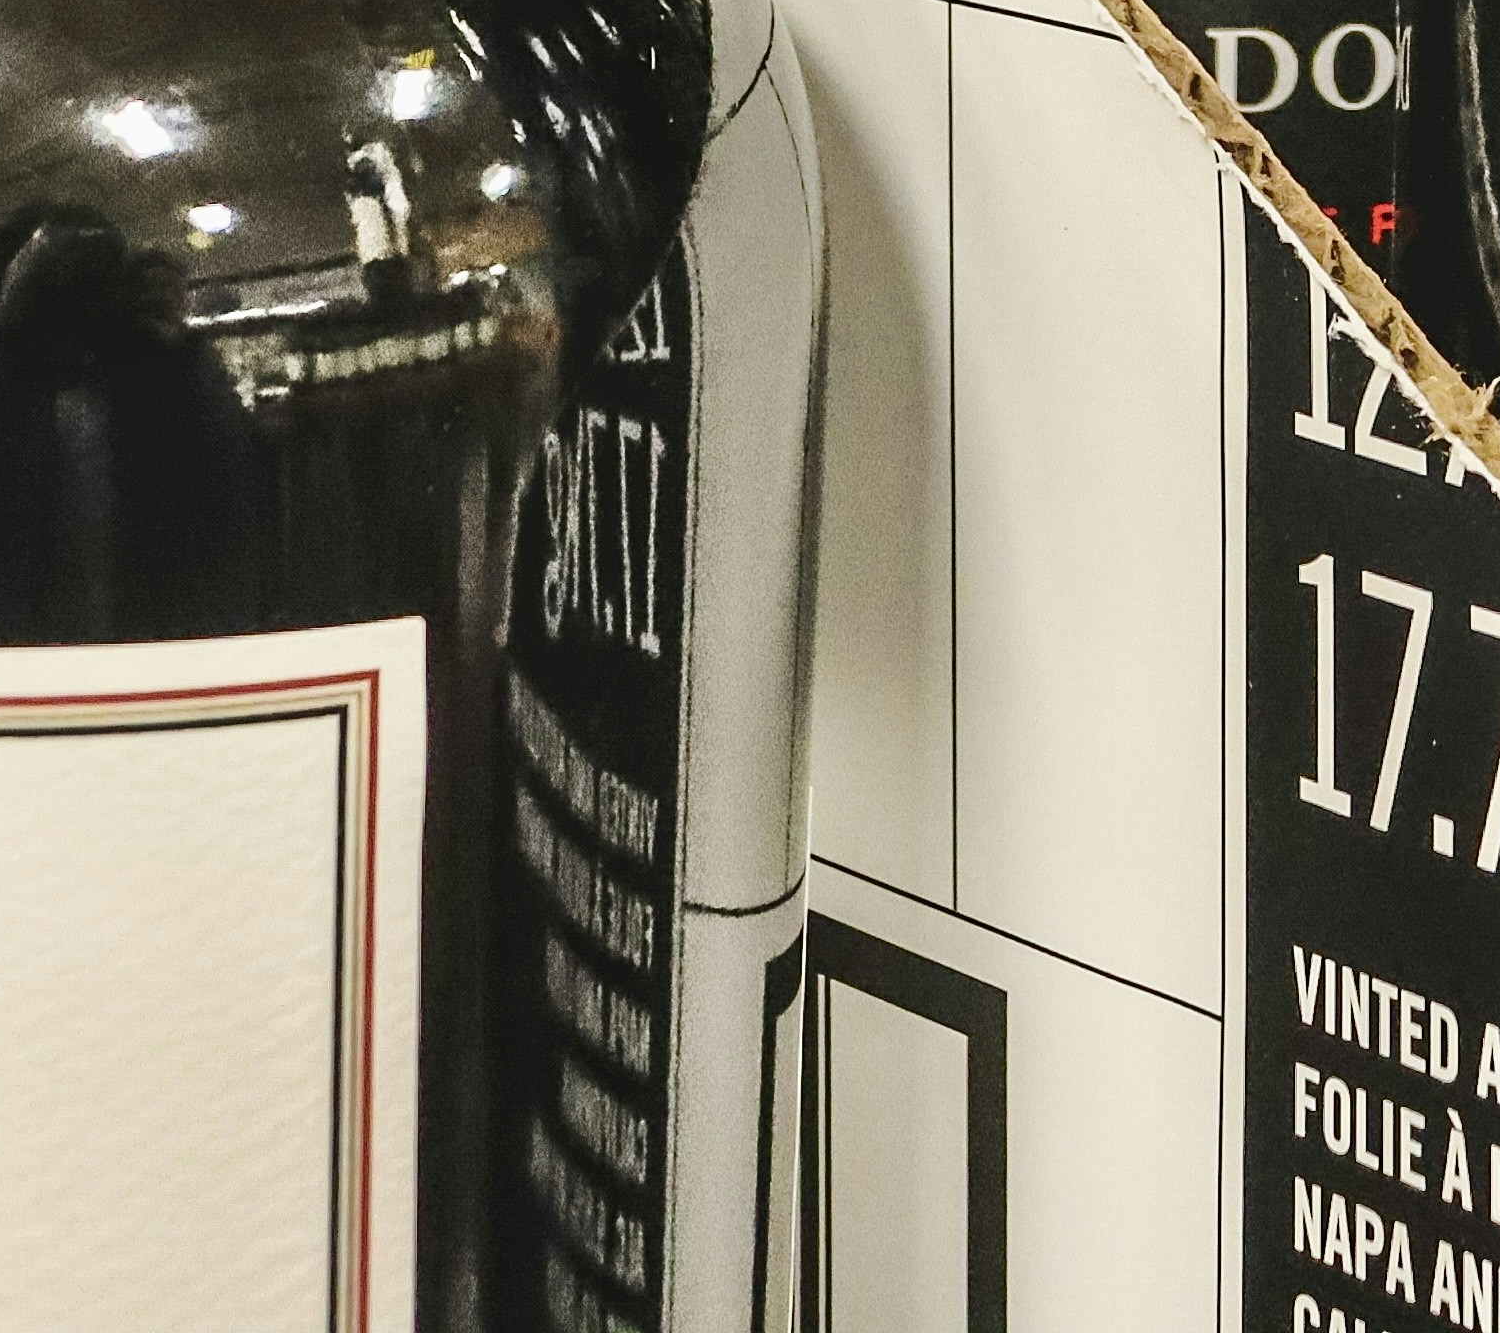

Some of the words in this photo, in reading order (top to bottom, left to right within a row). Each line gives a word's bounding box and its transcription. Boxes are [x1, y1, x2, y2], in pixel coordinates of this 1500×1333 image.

[1292, 945, 1459, 1084] VINTED
[1294, 1062, 1427, 1193] FOLIE
[1441, 1108, 1474, 1212] À
[1293, 1175, 1417, 1305] NAPA
